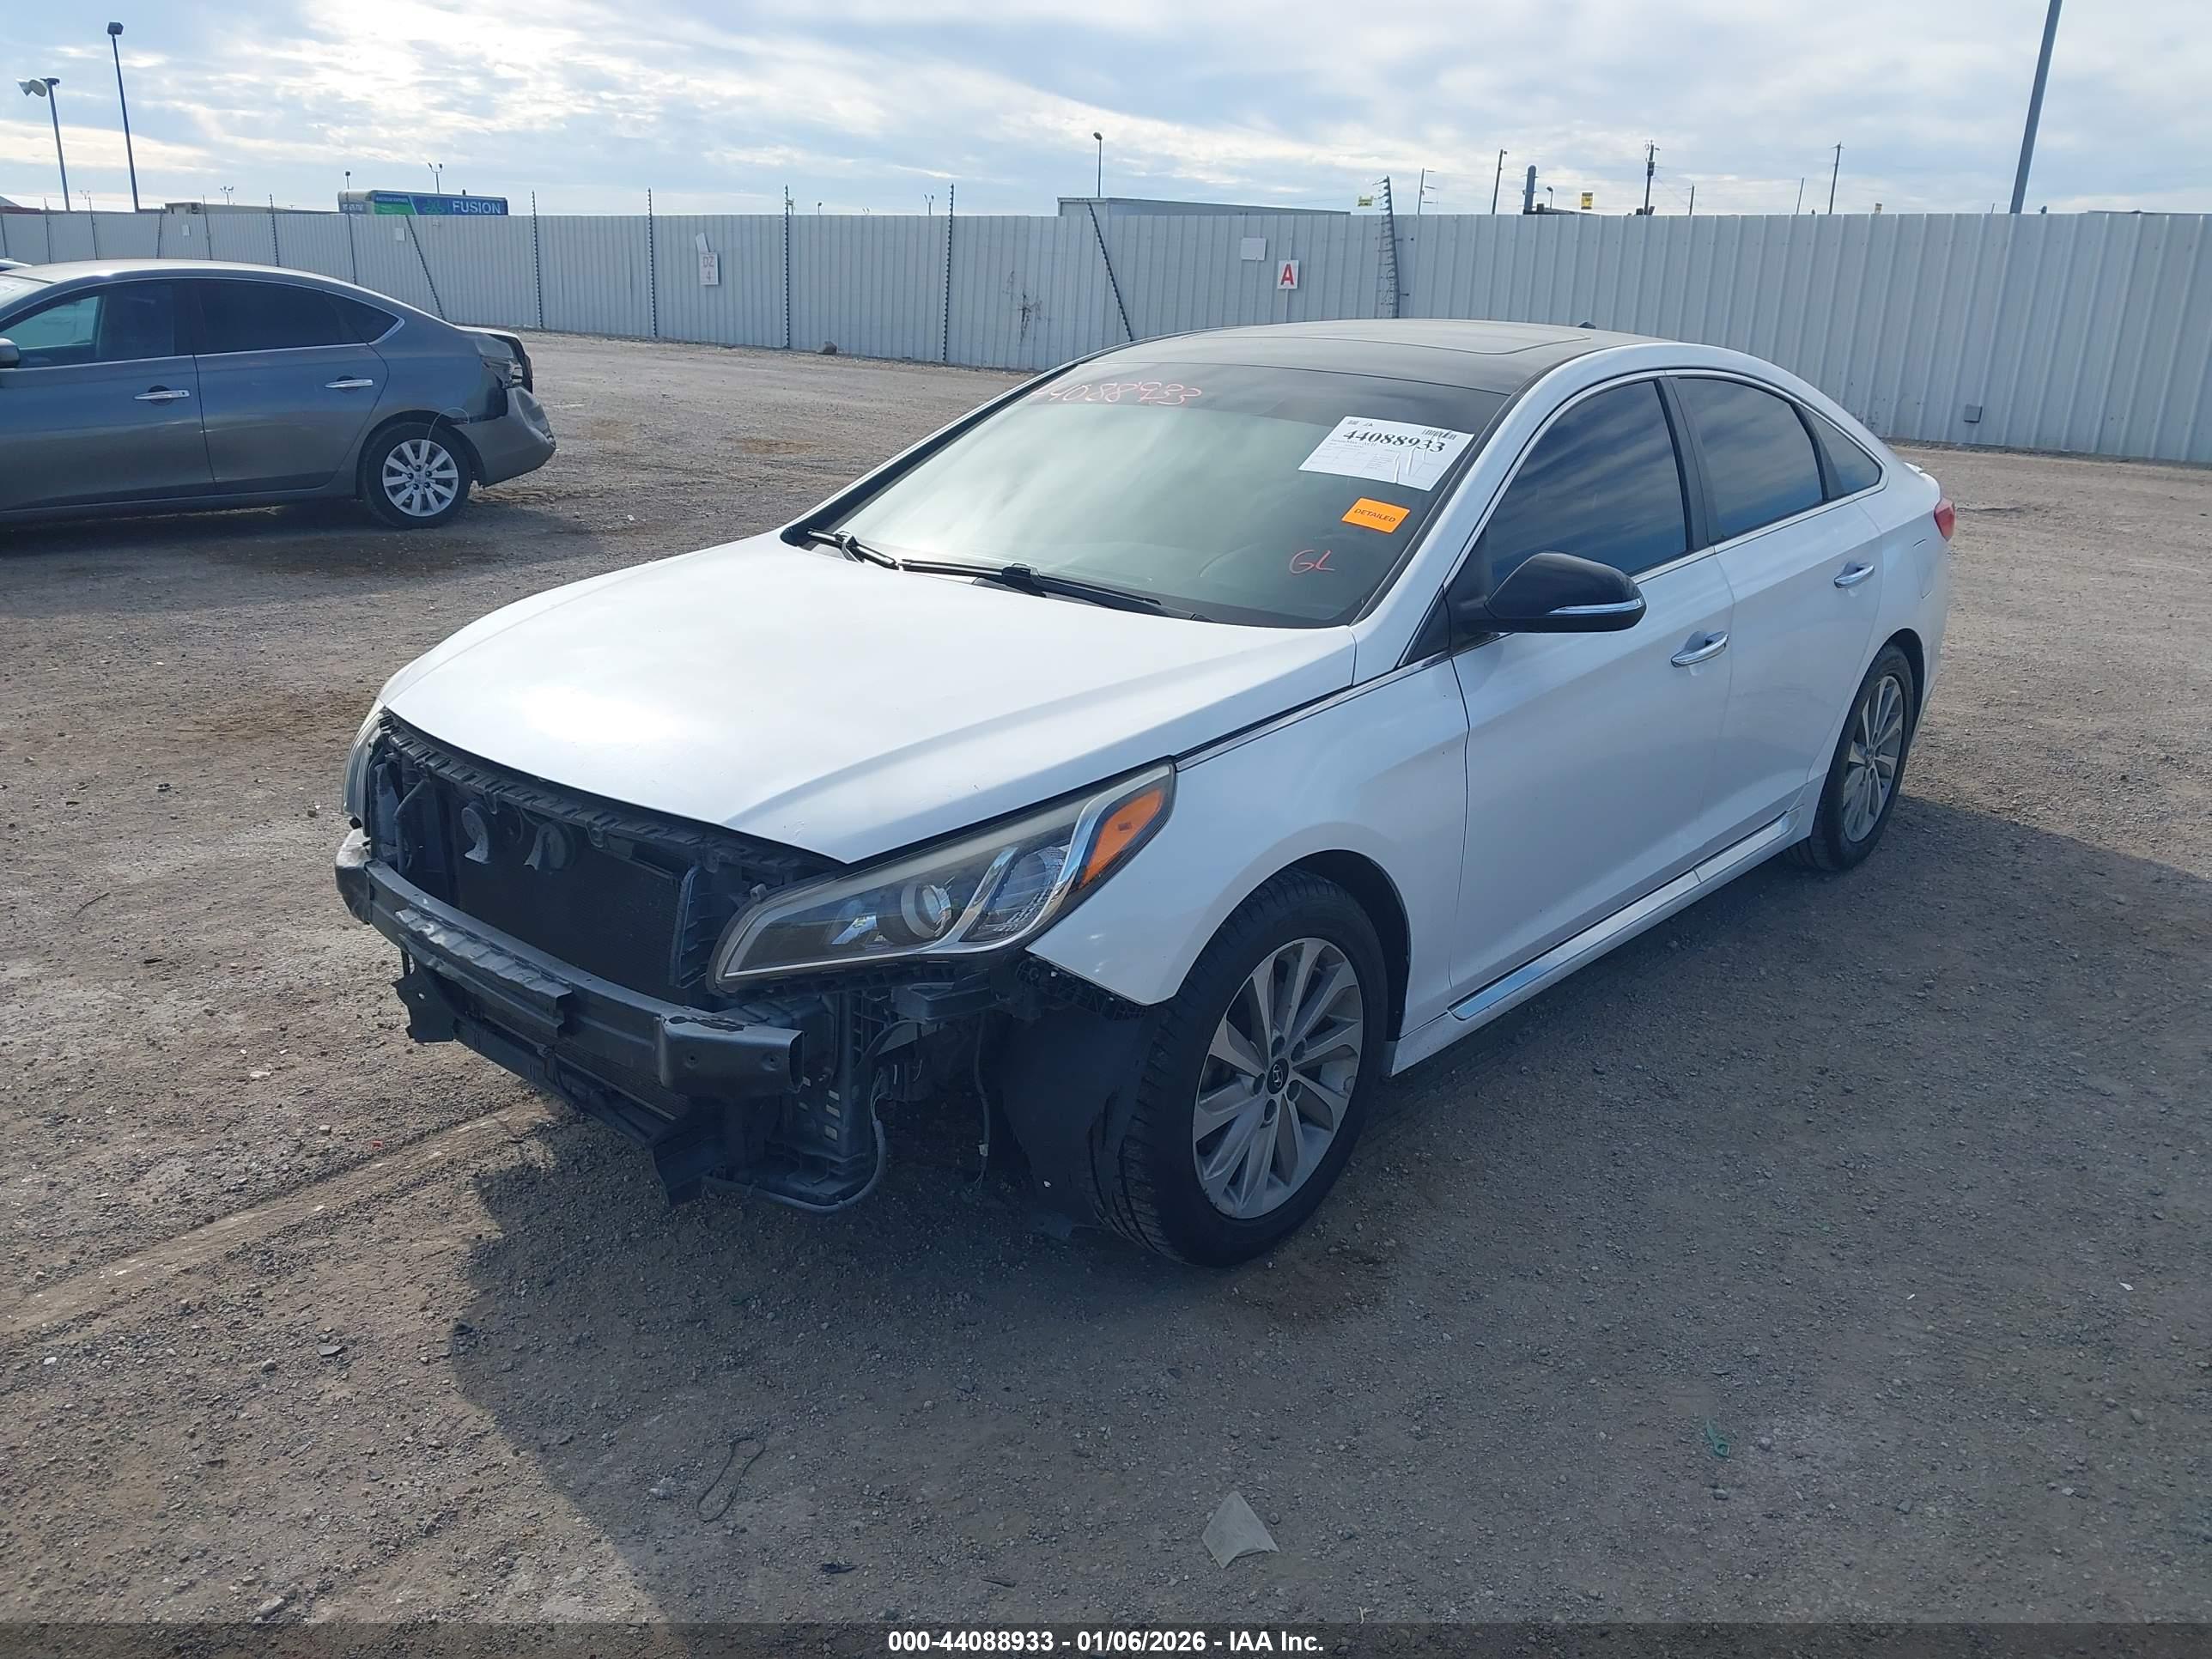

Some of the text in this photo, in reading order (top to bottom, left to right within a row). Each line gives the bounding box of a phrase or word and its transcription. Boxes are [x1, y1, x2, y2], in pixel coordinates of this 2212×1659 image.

[452, 200, 501, 214] FUSION
[1280, 264, 1294, 285] A
[1343, 429, 1447, 453] 44088933
[1354, 508, 1396, 523] DETAILED
